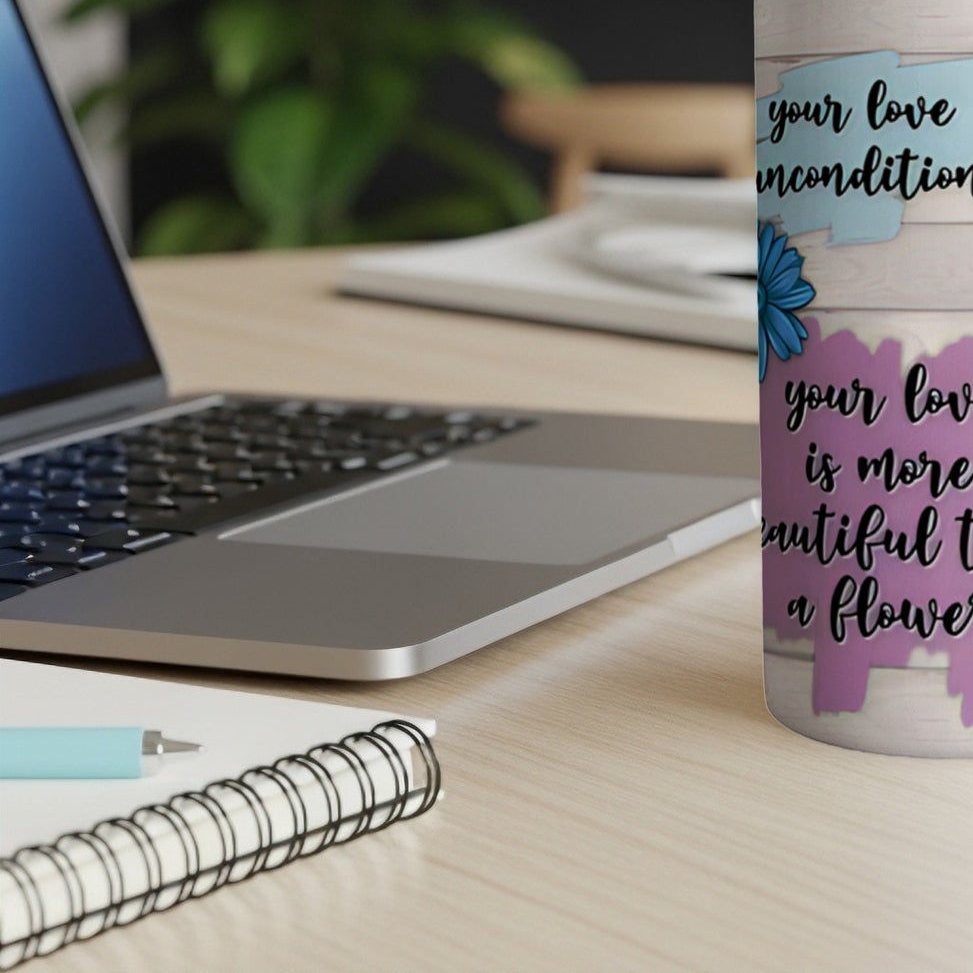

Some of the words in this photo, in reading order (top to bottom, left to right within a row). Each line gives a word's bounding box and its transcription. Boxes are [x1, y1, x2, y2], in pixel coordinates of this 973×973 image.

[768, 93, 853, 145] your
[866, 79, 957, 131] love
[784, 378, 887, 434] your
[804, 441, 842, 494] is
[786, 592, 816, 628] a
